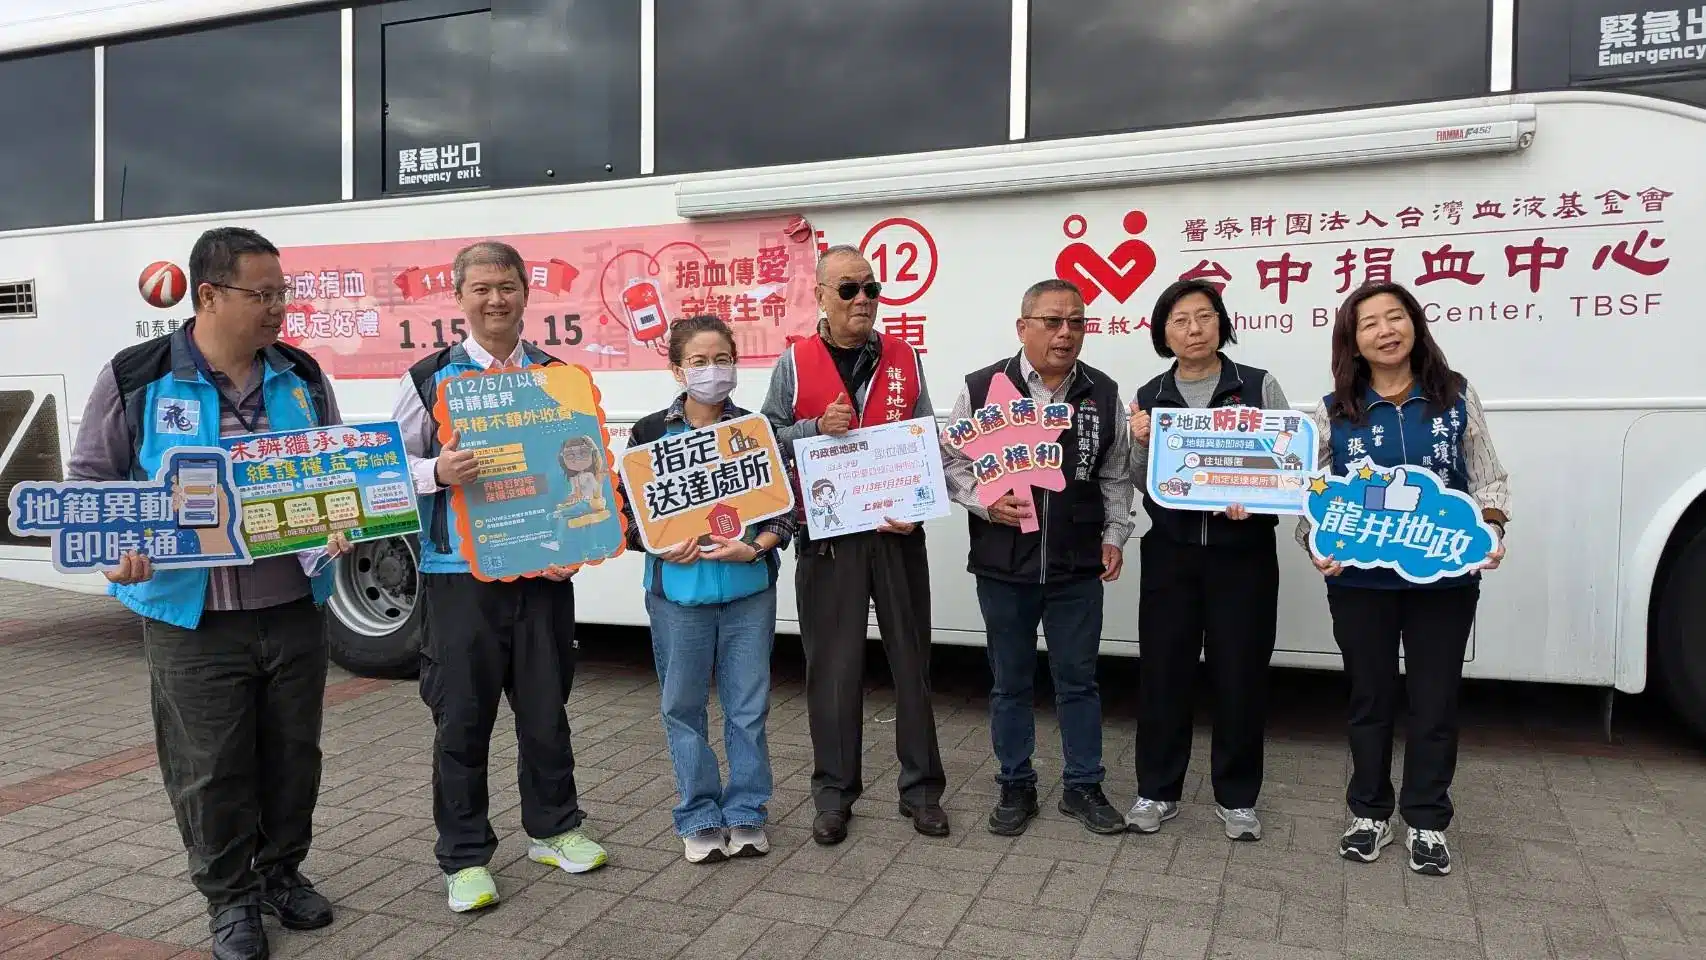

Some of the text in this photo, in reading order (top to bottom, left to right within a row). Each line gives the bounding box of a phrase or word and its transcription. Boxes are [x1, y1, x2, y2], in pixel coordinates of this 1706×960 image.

[1599, 6, 1706, 49] 緊急出
[1599, 44, 1706, 66] Emergency
[1436, 129, 1464, 141] FIAMMA
[399, 142, 481, 173] 緊急出口
[399, 167, 481, 185] Emergency exit
[1181, 187, 1674, 243] 醫療財團法人台灣血液基金會
[529, 266, 549, 288] 月
[675, 244, 790, 289] 捐血傳愛
[871, 241, 919, 283] 12
[1178, 228, 1670, 305] 台中捐血中心
[284, 269, 367, 300] 成捐血
[277, 308, 381, 339] 限定好禮
[681, 291, 787, 327] 守護生命
[1234, 311, 1293, 334] hung
[1423, 302, 1544, 324] Center,
[1570, 293, 1663, 318] TBSF
[135, 318, 188, 338] 和泰集
[517, 313, 583, 346] .15
[882, 312, 928, 354] 車
[1084, 315, 1152, 336] 血救人
[446, 371, 549, 396] 112/5/1以後
[885, 366, 907, 422] 龍井地政
[449, 391, 515, 414] 申請鑑界
[949, 399, 1072, 446] 地籍清理
[1176, 408, 1300, 433] 地政防詐三寶
[1371, 424, 1384, 447] 秘書
[230, 431, 339, 461] 未辦繼承
[652, 430, 720, 477] 指定
[809, 440, 870, 461] 內政部地政司
[1184, 438, 1255, 449] 地籍異動即時通
[1347, 437, 1368, 464] 張
[246, 452, 353, 484] 維護權益
[974, 443, 1062, 483] 保權利
[647, 451, 771, 520] 送達處所
[22, 491, 174, 526] 地籍異動
[65, 529, 180, 564] 即時通
[1320, 499, 1473, 566] 龍井地政
